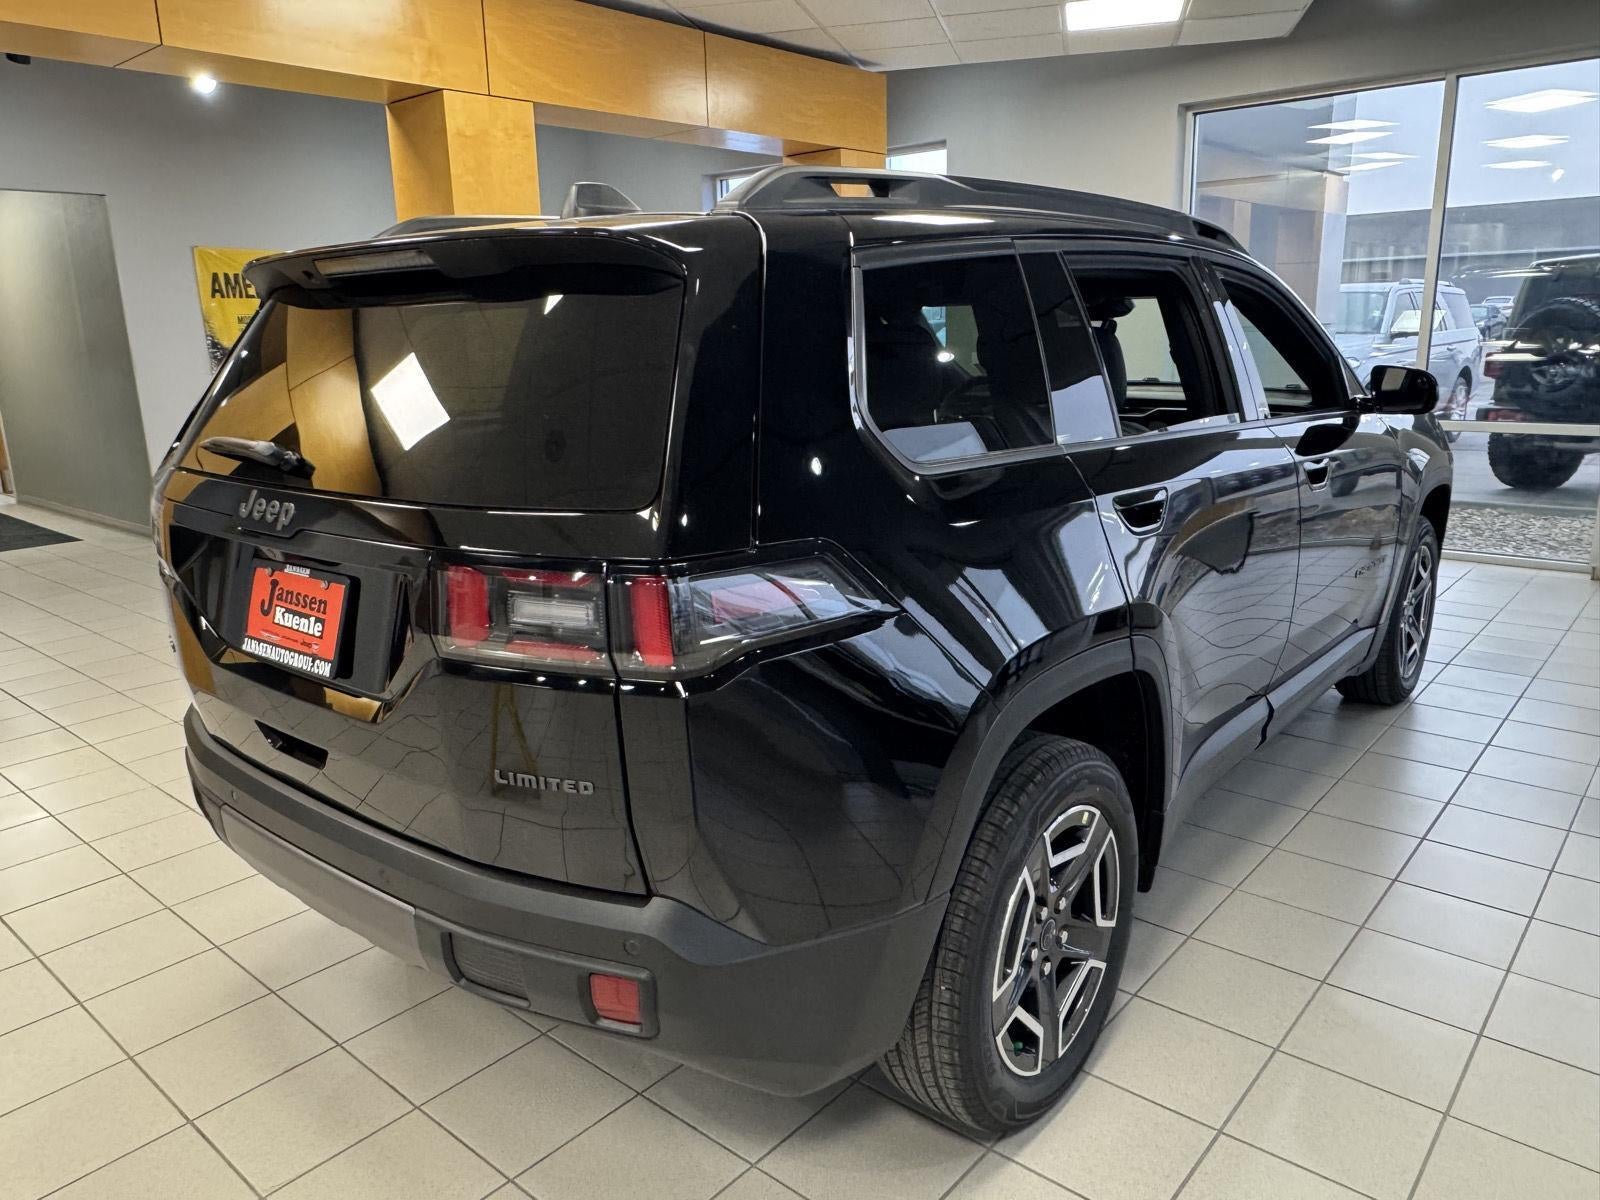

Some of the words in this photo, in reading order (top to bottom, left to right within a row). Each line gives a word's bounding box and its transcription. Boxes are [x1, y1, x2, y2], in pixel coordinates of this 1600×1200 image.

[239, 489, 295, 531] Jeep
[260, 578, 328, 616] Janssen
[273, 605, 323, 637] Kuenle
[494, 769, 595, 795] LIMITED
